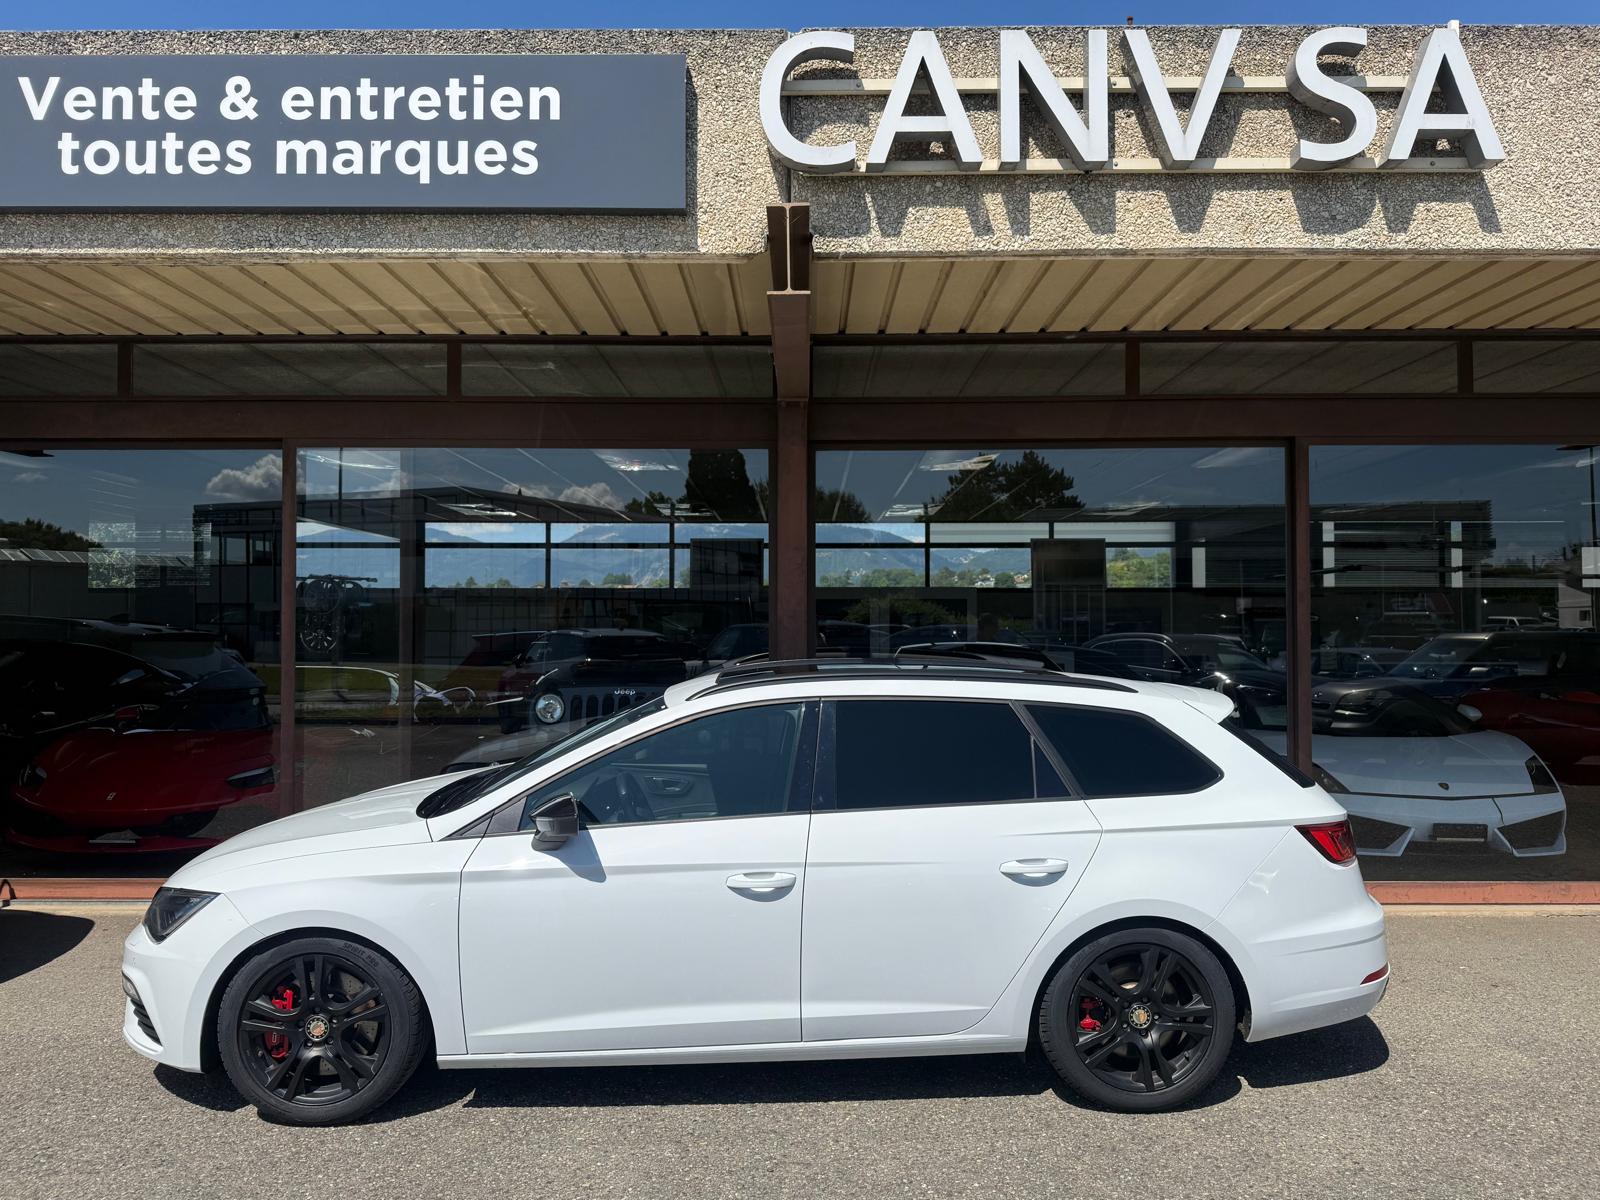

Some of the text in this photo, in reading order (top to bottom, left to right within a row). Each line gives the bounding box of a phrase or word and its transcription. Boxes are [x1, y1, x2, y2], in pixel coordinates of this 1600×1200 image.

[17, 74, 562, 121] Vente & entretien
[758, 26, 1505, 170] CANV SA
[57, 132, 540, 185] toutes marques
[614, 687, 636, 696] Jeep
